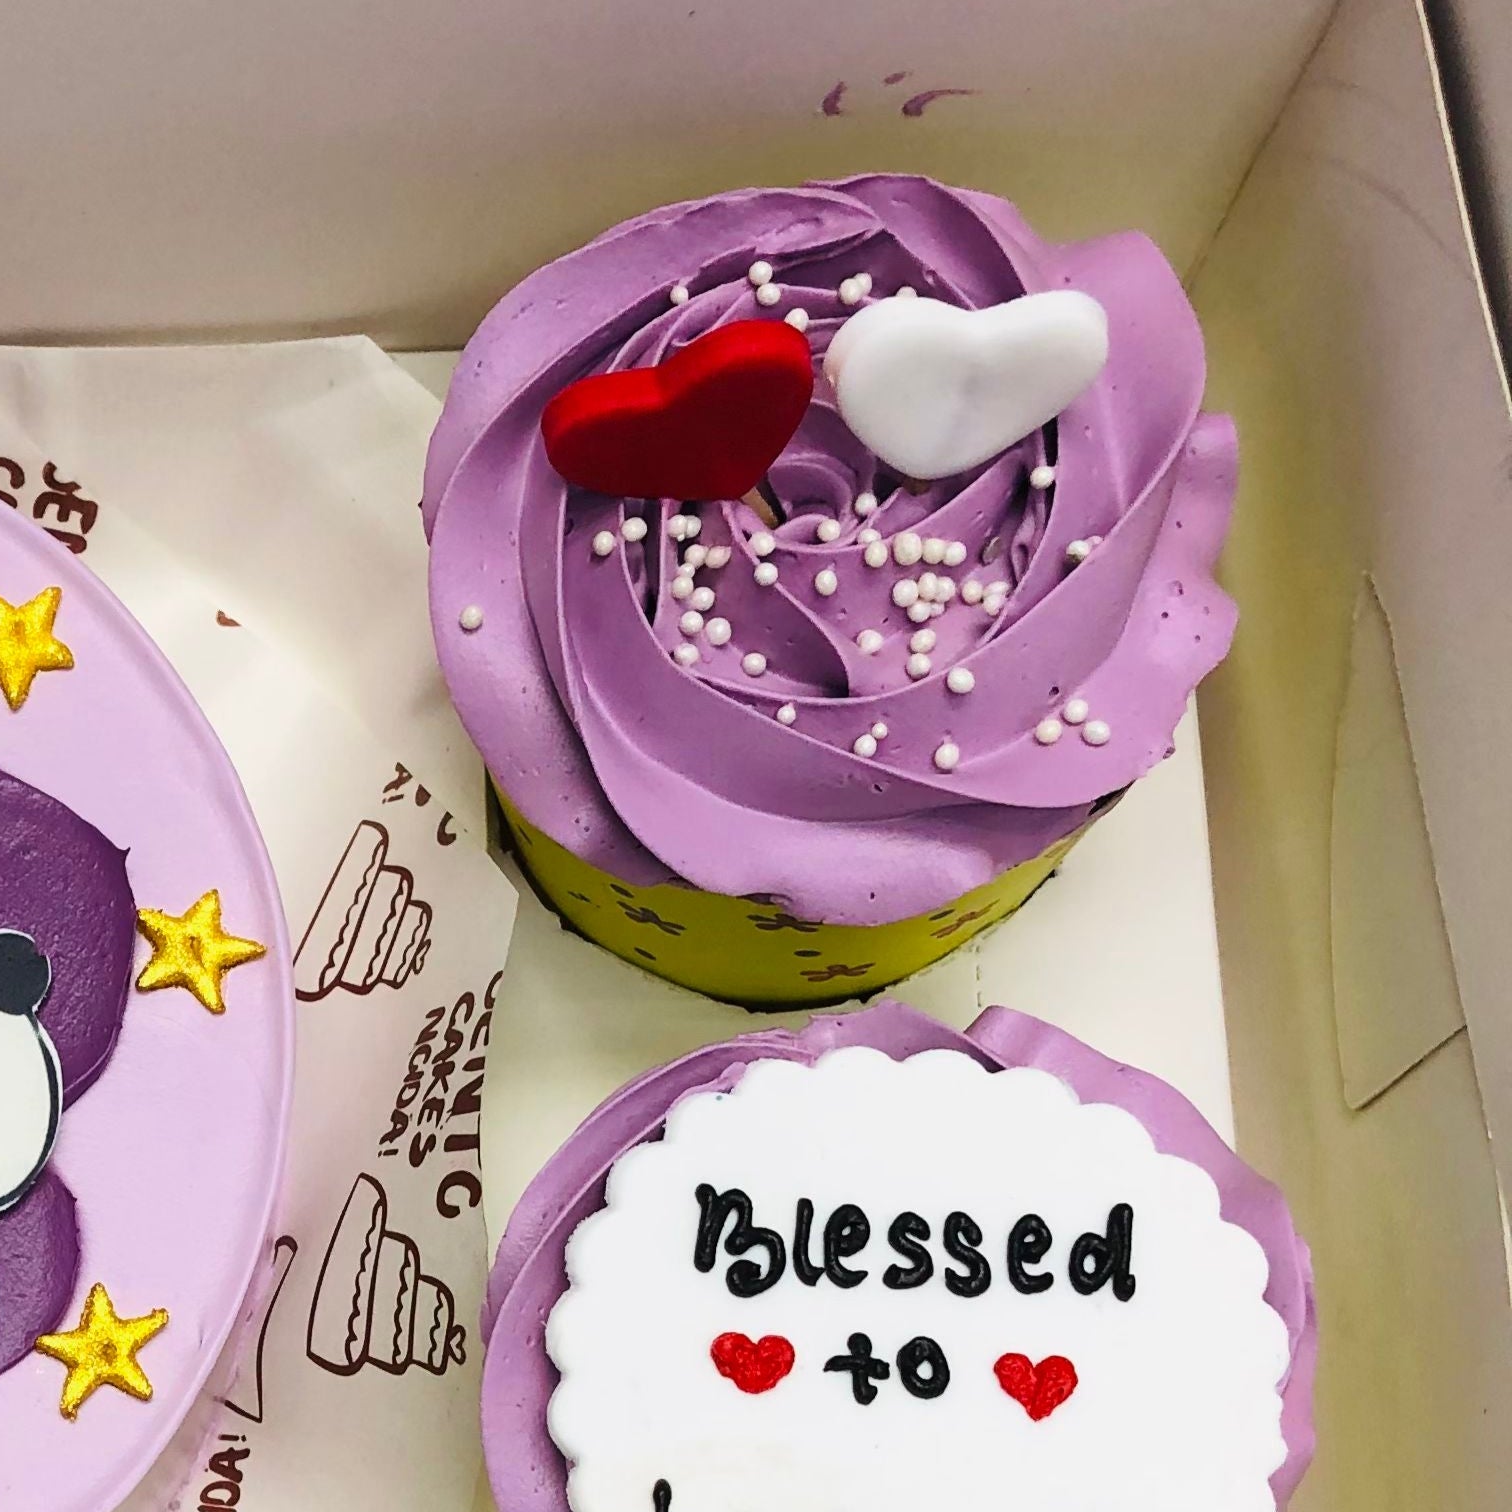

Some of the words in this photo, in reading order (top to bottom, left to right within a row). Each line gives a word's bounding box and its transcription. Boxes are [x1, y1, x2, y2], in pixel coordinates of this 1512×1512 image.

[409, 991, 475, 1168] CAKES
[694, 1183, 1136, 1303] Blessed
[824, 1332, 951, 1406] to
